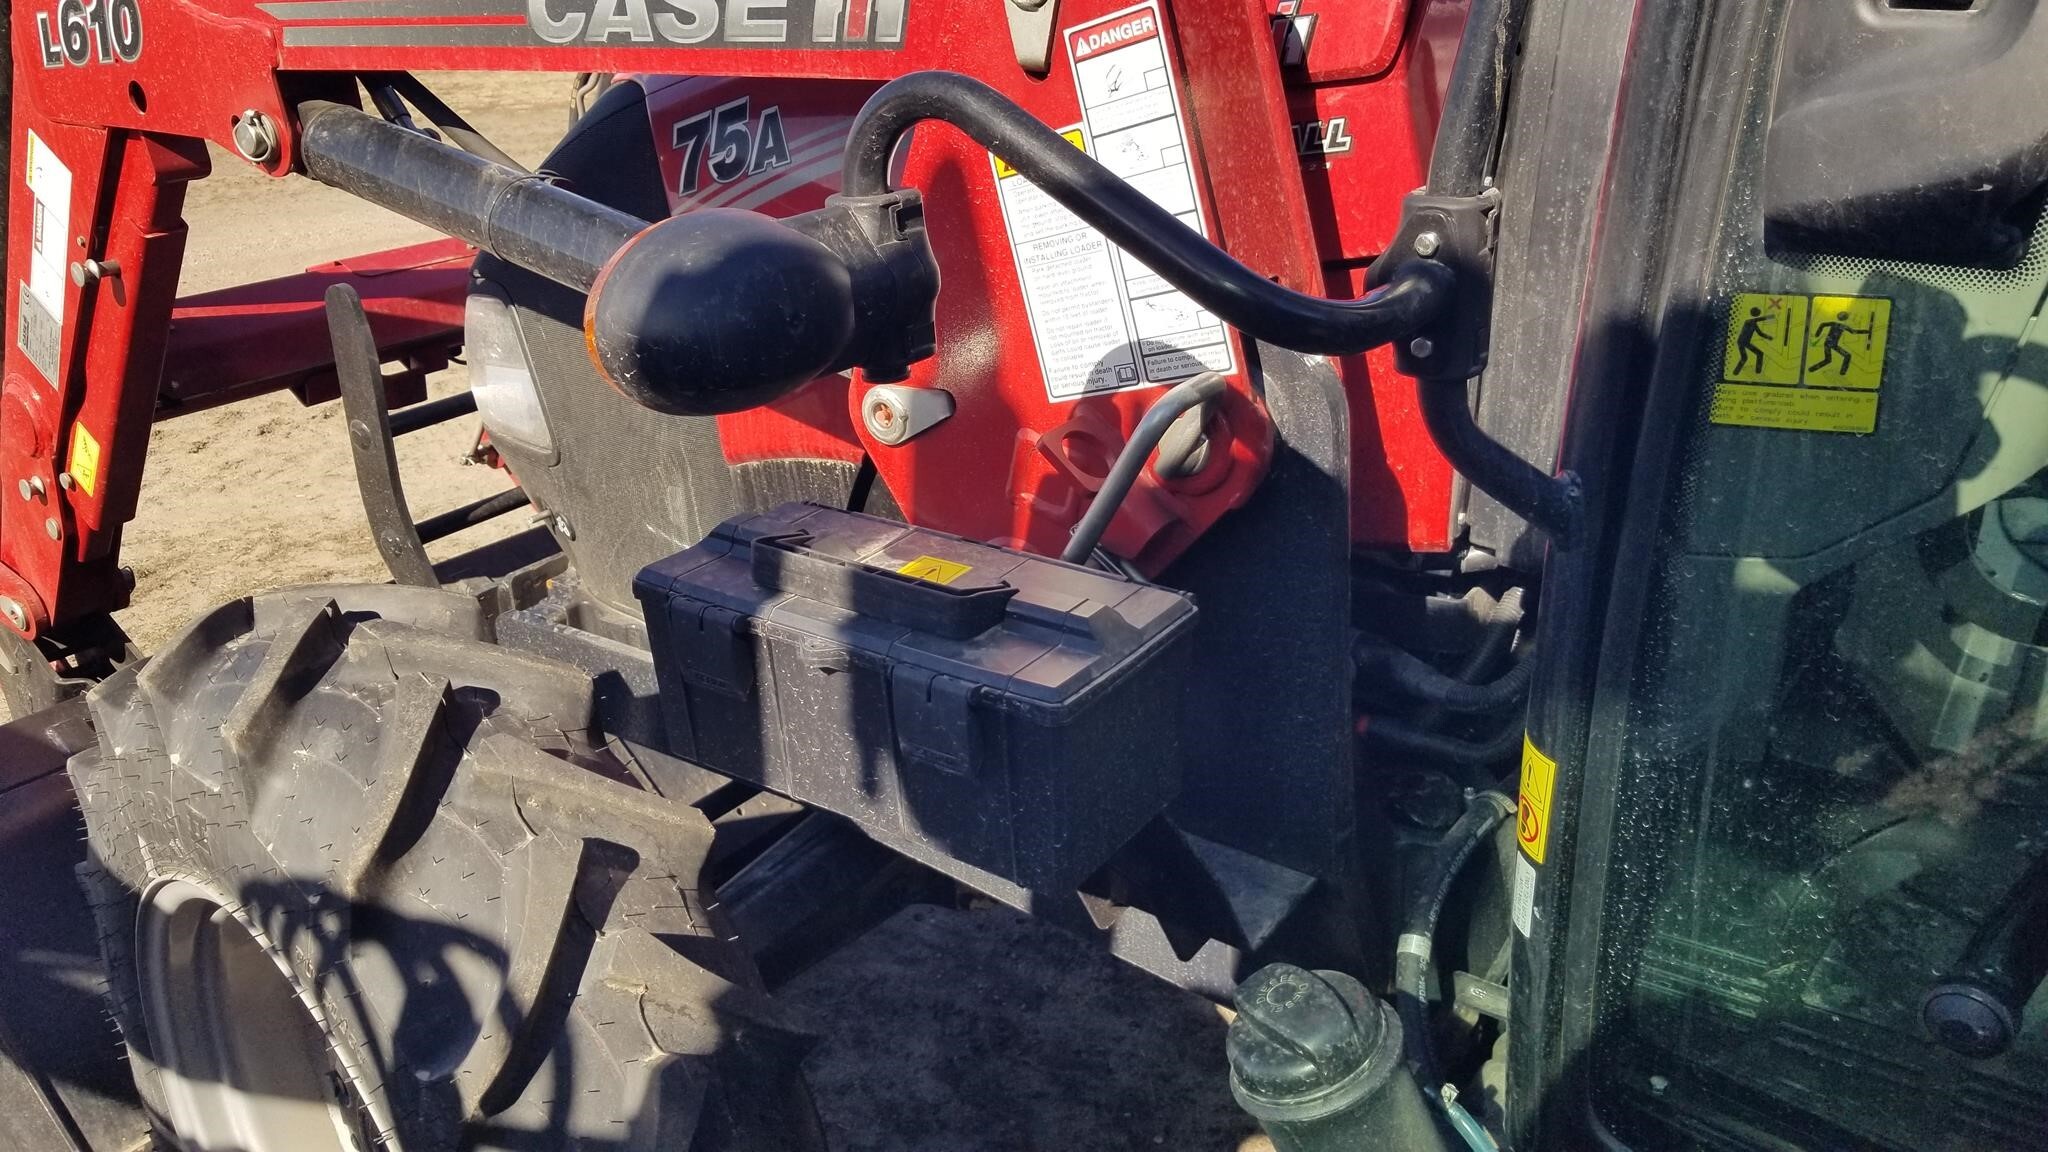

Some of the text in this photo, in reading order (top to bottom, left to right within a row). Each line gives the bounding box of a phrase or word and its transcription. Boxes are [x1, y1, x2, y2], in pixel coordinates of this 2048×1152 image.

[528, 0, 788, 43] CASE
[38, 0, 142, 68] L610
[1089, 17, 1155, 51] DANGER
[672, 96, 791, 197] 75A
[1023, 241, 1102, 264] INSTALLING LOADER
[1033, 232, 1087, 251] REMOVING OR
[1094, 366, 1112, 375] death
[1147, 357, 1167, 366] Failure
[1175, 352, 1195, 363] comply
[1156, 365, 1172, 373] death
[1181, 361, 1202, 369] serious
